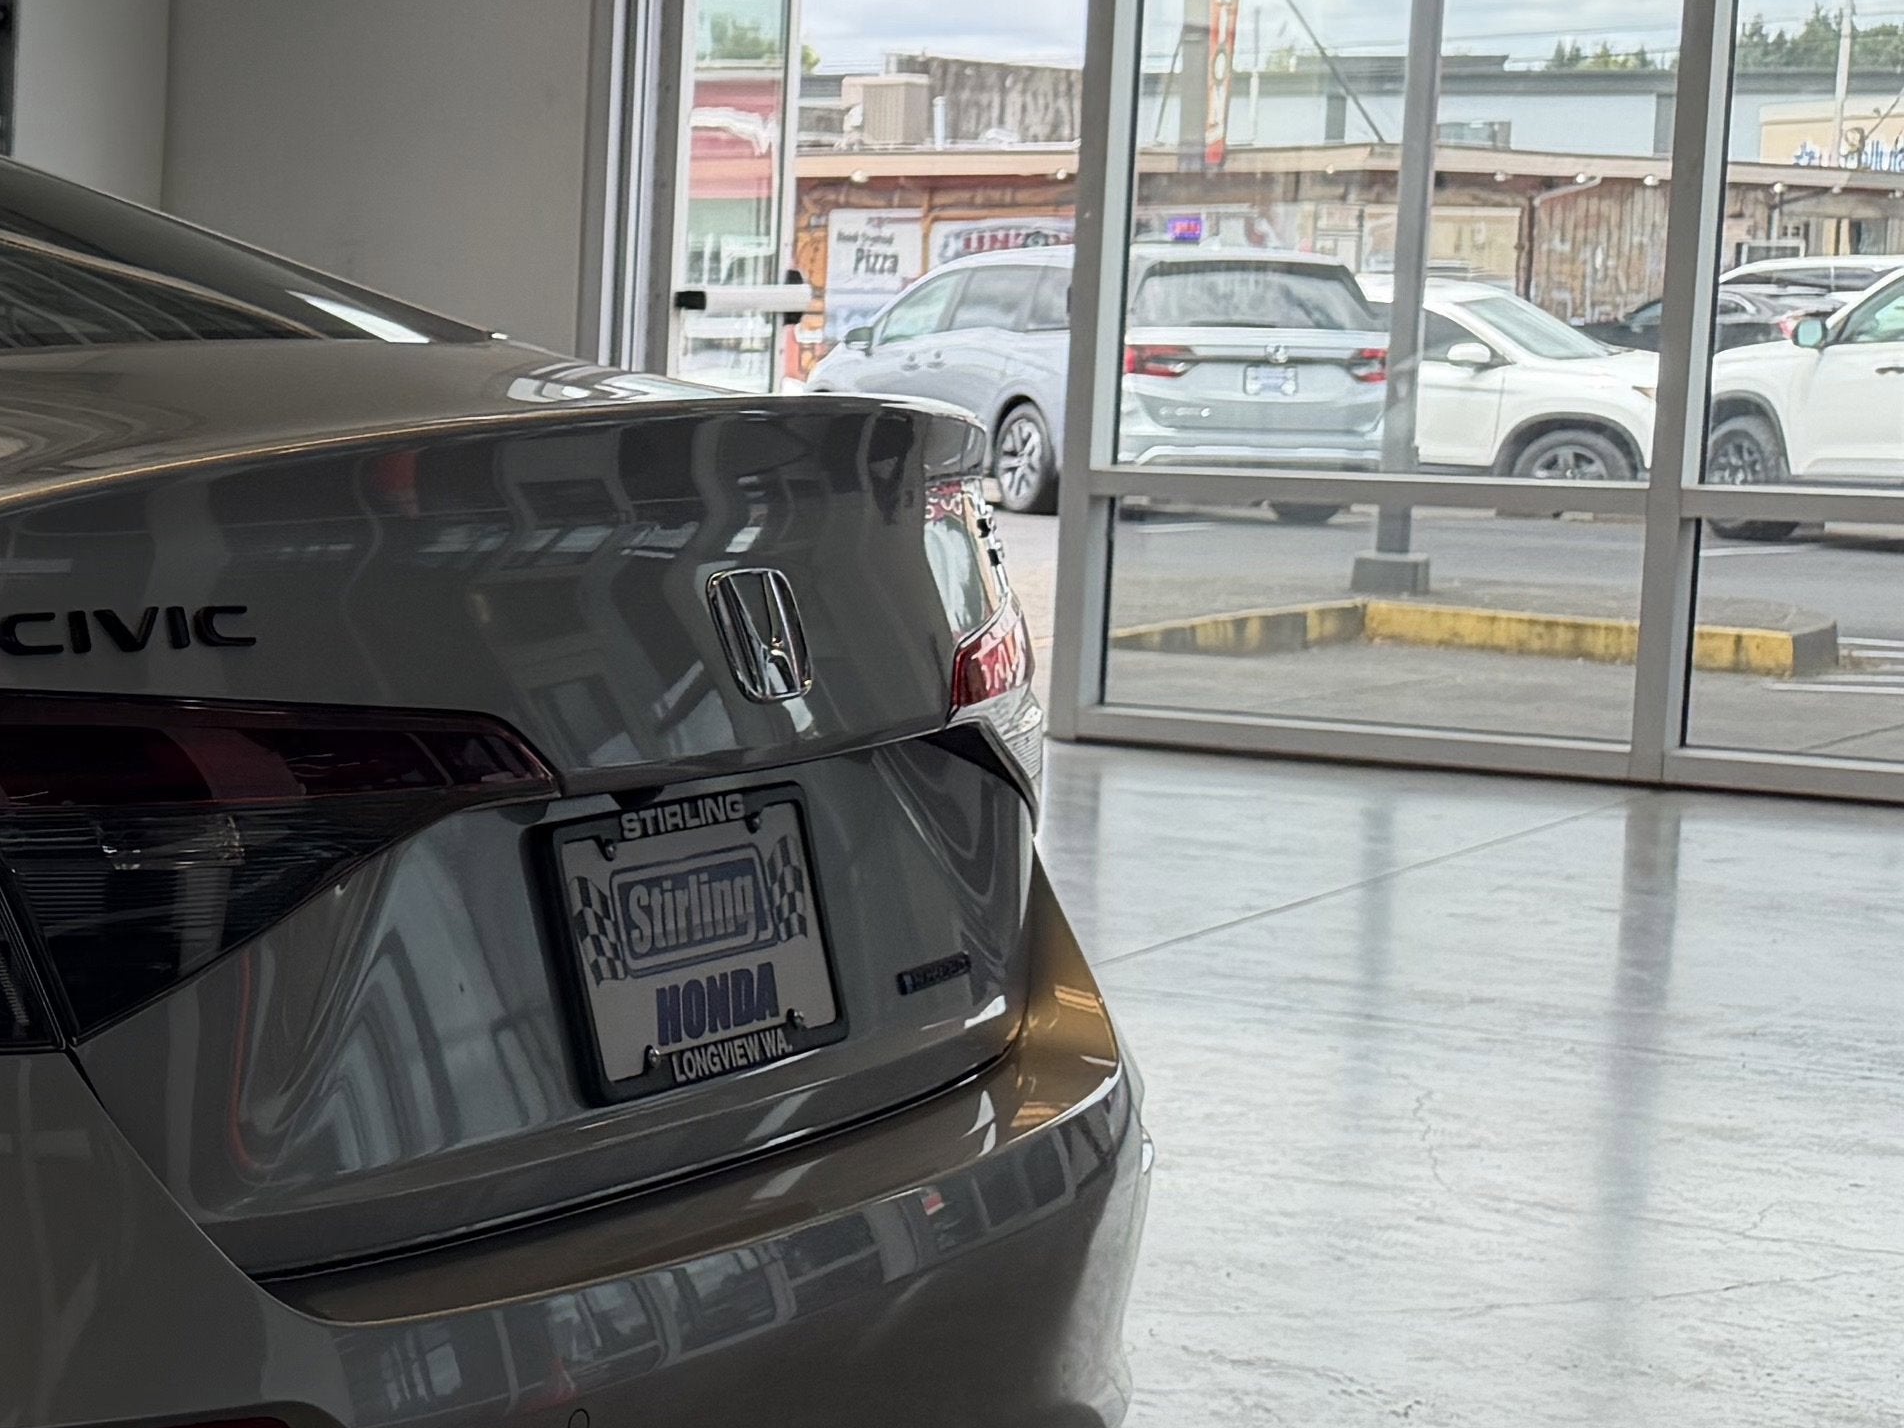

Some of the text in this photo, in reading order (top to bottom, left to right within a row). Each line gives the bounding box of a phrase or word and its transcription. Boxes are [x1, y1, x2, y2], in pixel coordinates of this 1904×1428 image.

[853, 248, 899, 276] Pizza
[620, 793, 746, 840] STIRLING
[628, 872, 755, 956] Stirling
[656, 961, 780, 1047] HONDA
[671, 1034, 762, 1083] LONGVIEW
